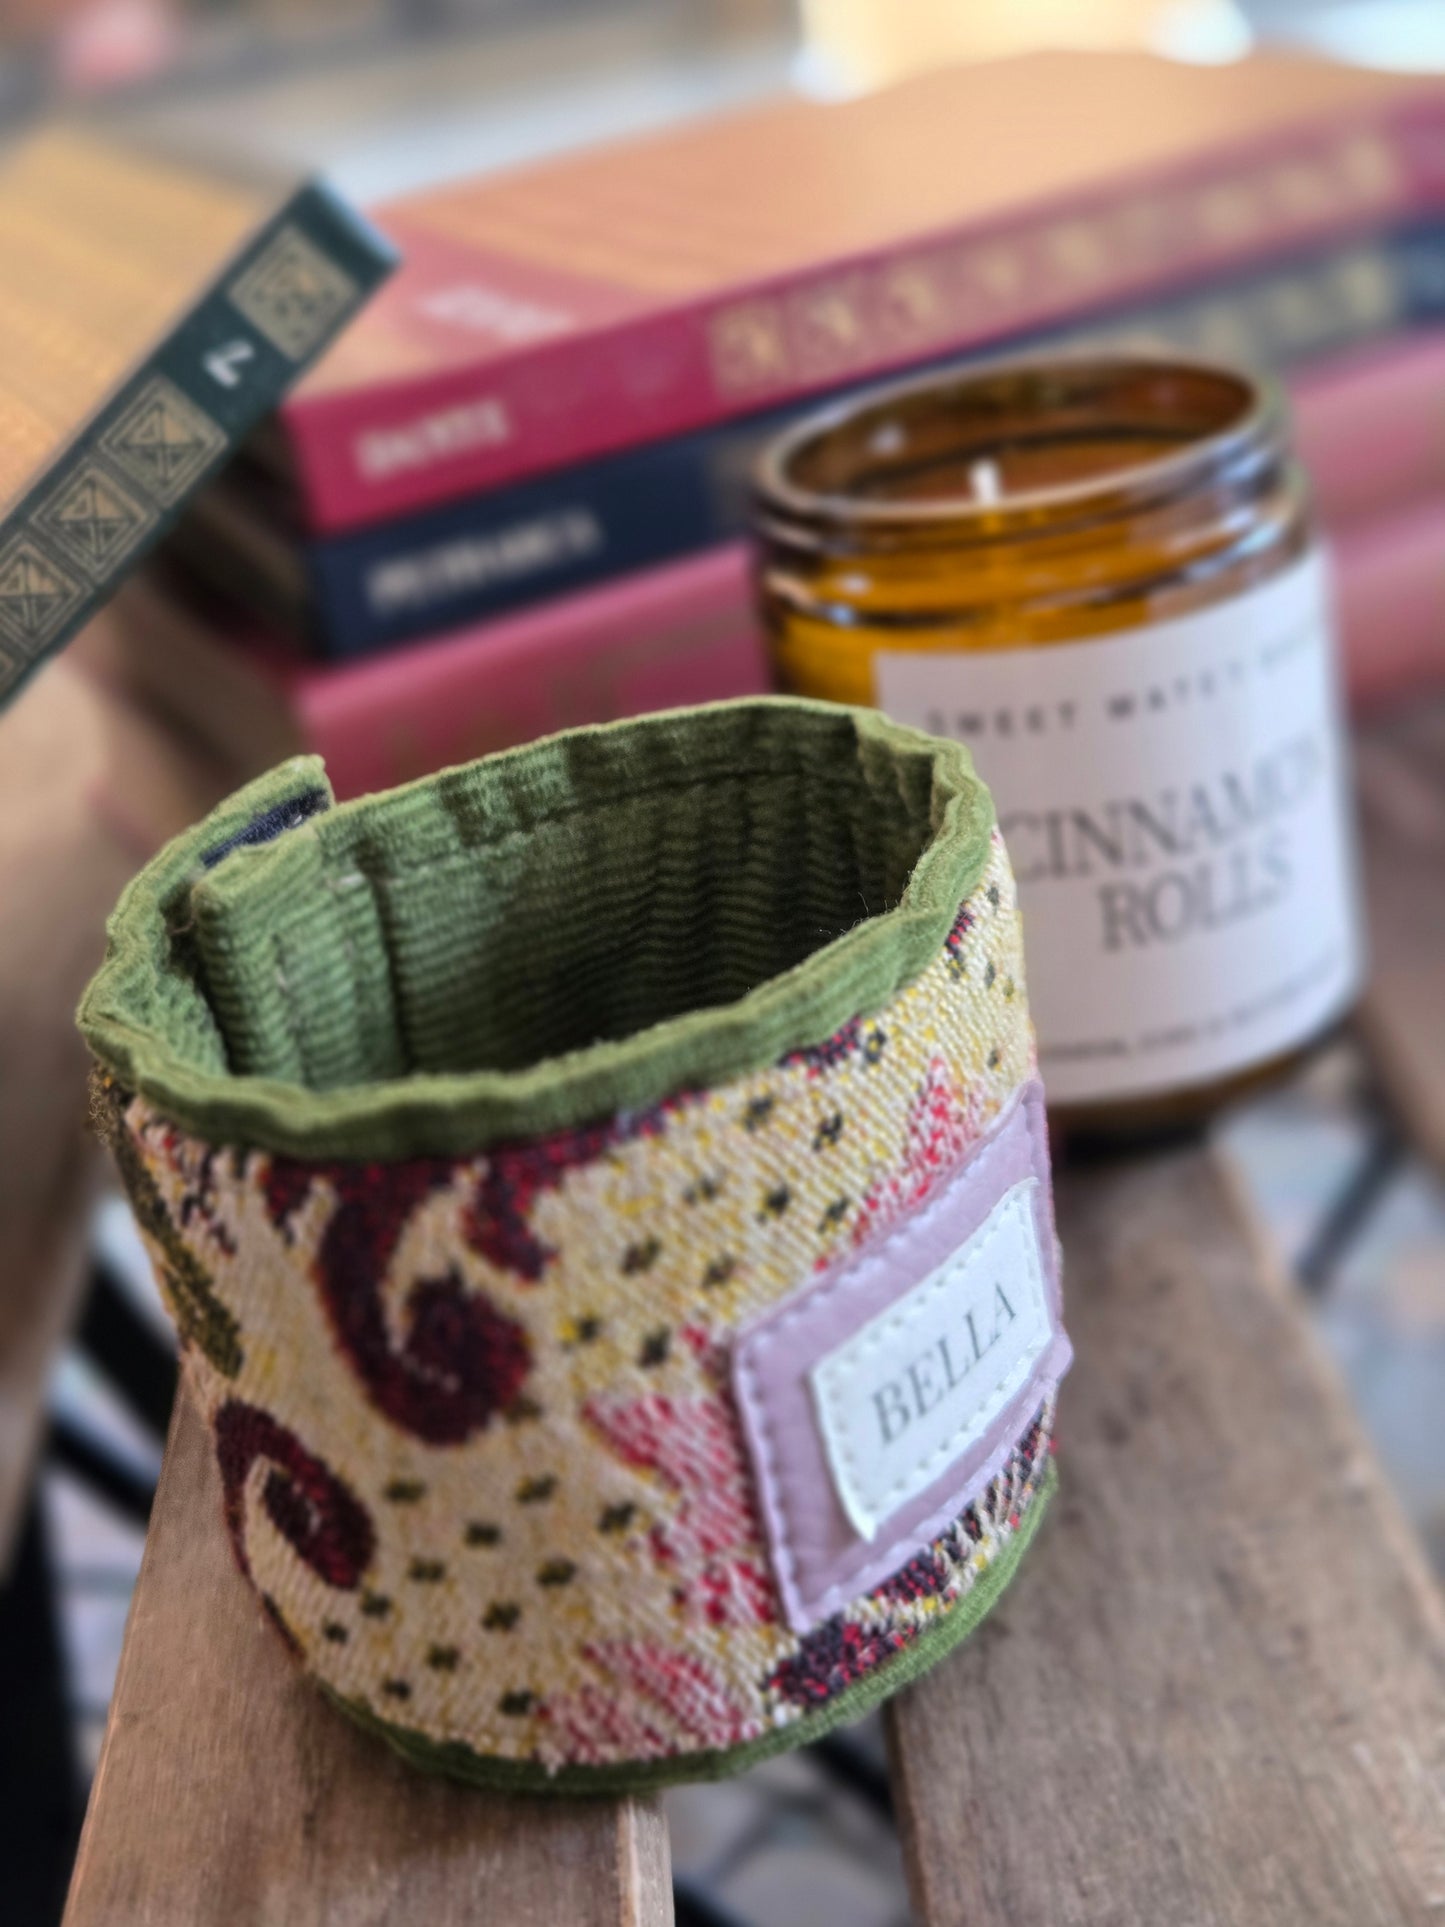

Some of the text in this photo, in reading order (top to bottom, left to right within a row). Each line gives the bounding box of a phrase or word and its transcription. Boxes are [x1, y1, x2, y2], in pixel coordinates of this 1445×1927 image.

[926, 699, 1077, 737] SWEET
[1000, 736, 1320, 885] CINNAMO
[1098, 826, 1293, 951] ROLLS
[871, 1282, 1017, 1444] BELLA
